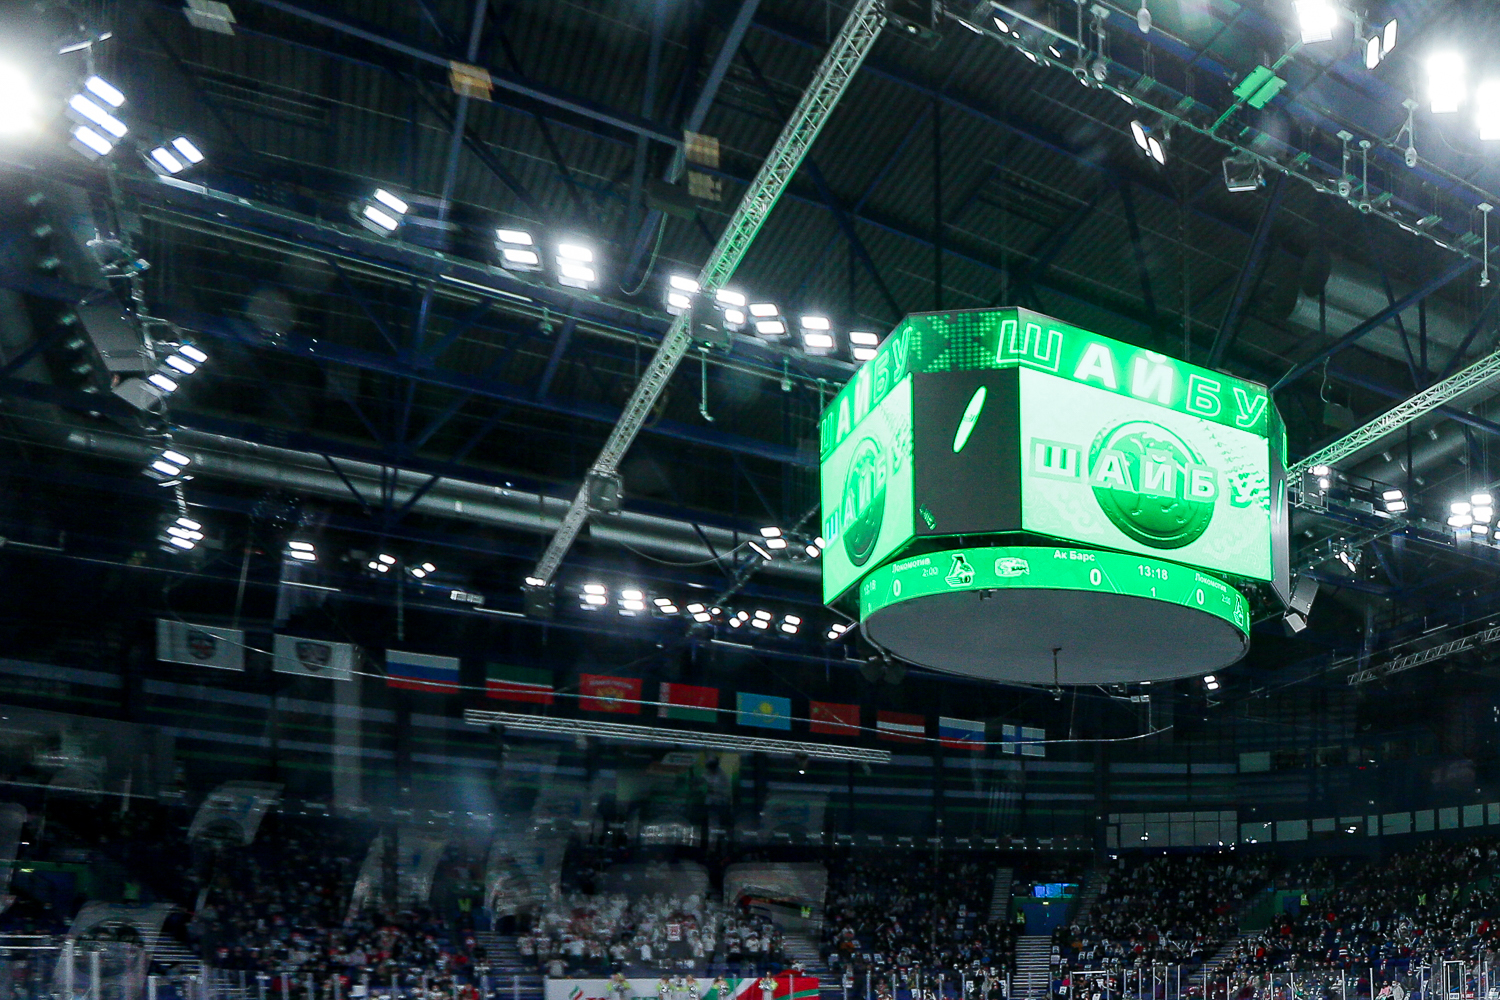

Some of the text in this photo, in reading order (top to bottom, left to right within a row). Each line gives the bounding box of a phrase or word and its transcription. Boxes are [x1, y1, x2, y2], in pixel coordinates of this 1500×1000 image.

[996, 319, 1268, 429] ШАЙБУ
[1031, 437, 1264, 507] ШАЙБУ
[1054, 550, 1095, 562] Ак Барс
[892, 558, 931, 574] Локомотив
[1138, 564, 1168, 580] 13:18
[1089, 568, 1102, 586] 0
[893, 579, 902, 597] 0
[1196, 588, 1205, 605] 0
